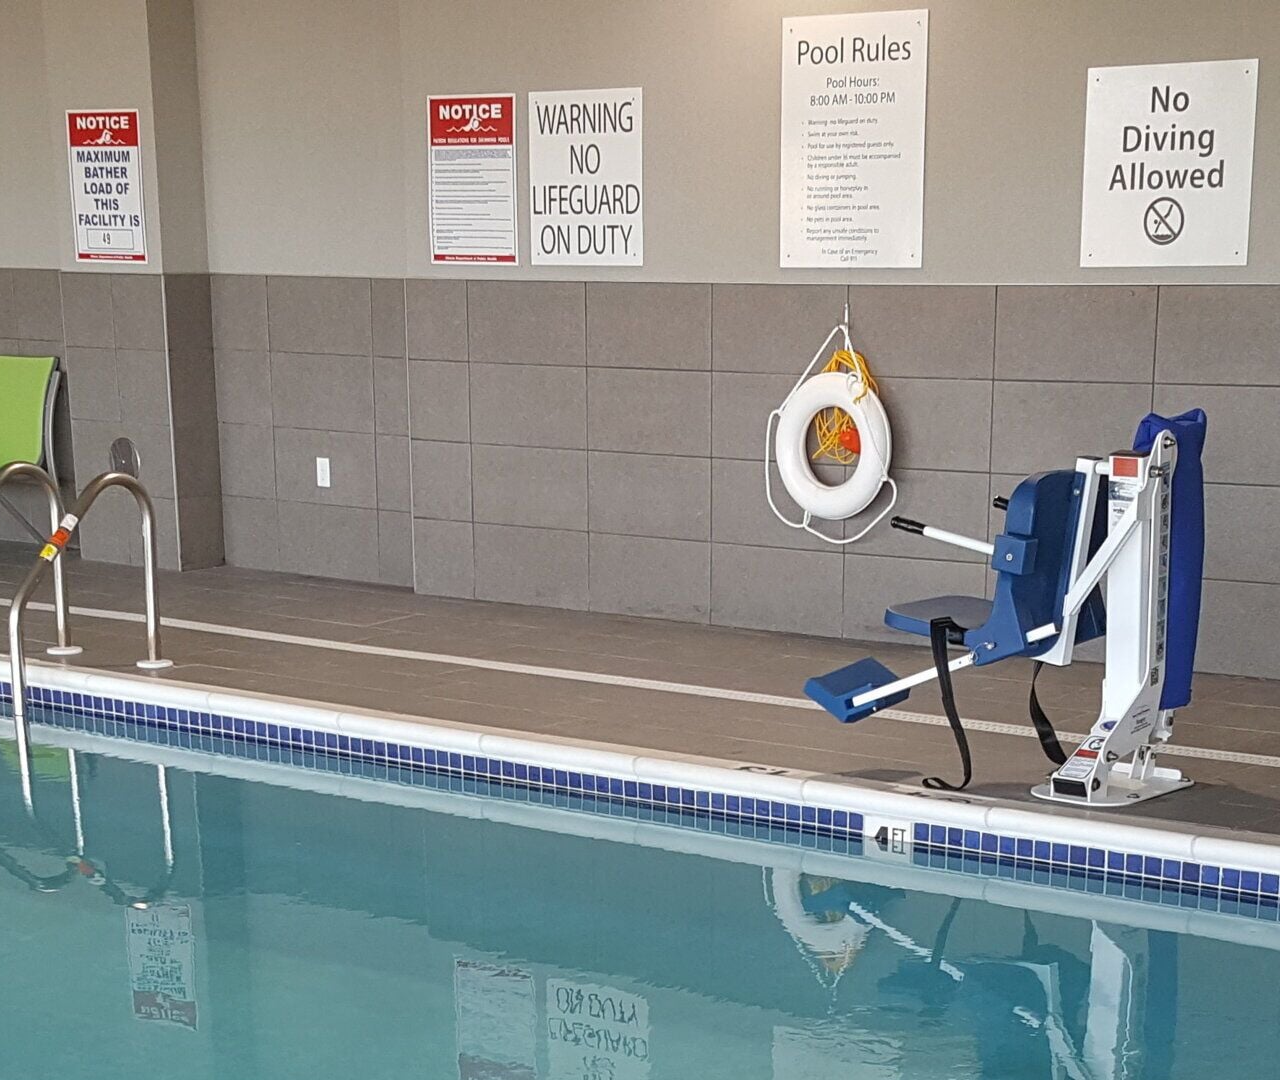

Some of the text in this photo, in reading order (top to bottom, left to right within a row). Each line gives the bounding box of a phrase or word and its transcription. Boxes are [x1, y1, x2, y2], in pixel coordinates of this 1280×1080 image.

[798, 34, 911, 66] Pool Rules
[827, 76, 879, 88] Pool Hours:
[810, 96, 829, 106] 8:00
[832, 95, 847, 105] AM
[855, 93, 878, 104] 10:00
[882, 92, 895, 103] PM
[1151, 85, 1190, 113] No
[439, 103, 502, 120] NOTICE
[536, 101, 634, 135] WARNING
[76, 116, 129, 130] NOTICE
[1122, 123, 1215, 158] Diving
[76, 151, 130, 163] MAXIMUM
[570, 144, 601, 175] NO
[84, 166, 128, 179] BATHER
[1108, 159, 1225, 191] Allowed
[84, 182, 130, 195] LOAD OF
[93, 198, 119, 211] THIS
[532, 184, 640, 215] LIFEGUARD
[78, 214, 140, 227] FACILITY IS
[541, 225, 632, 255] ON DUTY
